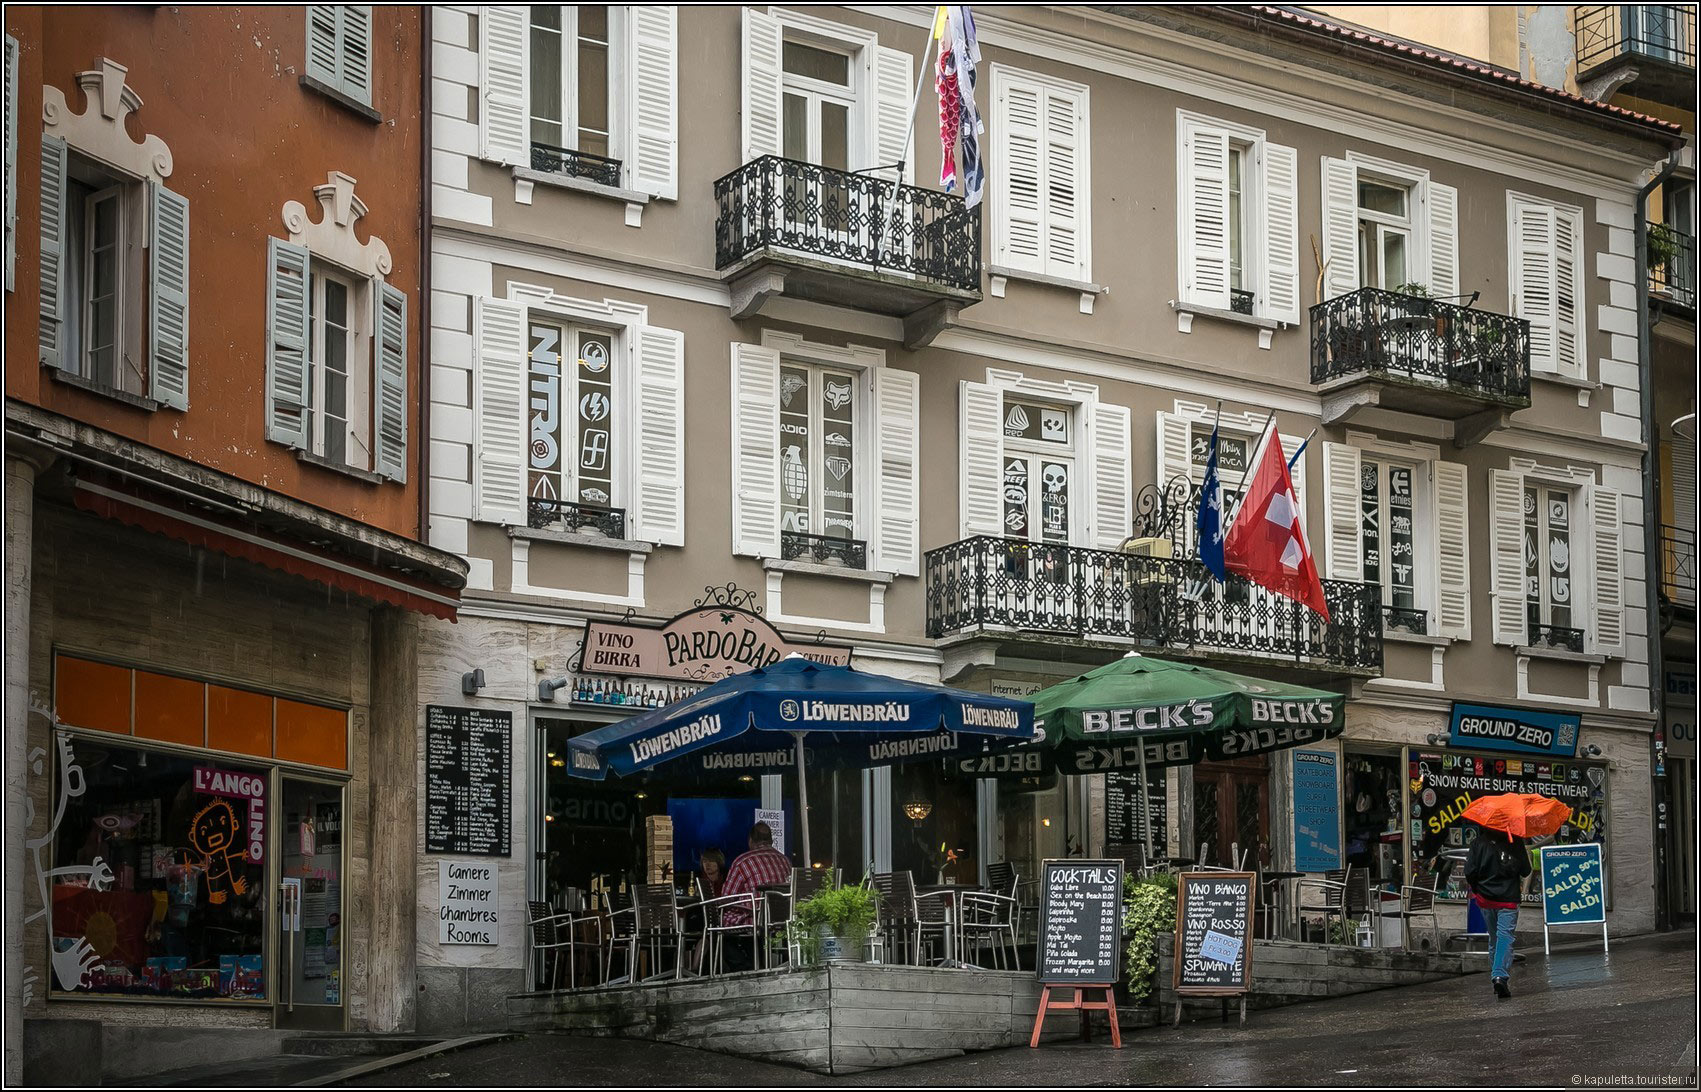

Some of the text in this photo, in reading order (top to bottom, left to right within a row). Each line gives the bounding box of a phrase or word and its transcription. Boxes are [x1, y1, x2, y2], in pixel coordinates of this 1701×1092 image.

[1220, 457, 1242, 467] RVCA
[1004, 475, 1027, 486] REEF
[1042, 492, 1067, 505] ZERO
[1391, 495, 1412, 506] etnies
[599, 632, 634, 649] VINO
[593, 650, 641, 667] BIRRA
[993, 681, 1023, 695] Internet
[803, 700, 910, 722] LÖWENBRÄU
[961, 703, 1019, 729] LÖWENBRÄU
[1082, 698, 1213, 733] BECK'S
[1251, 698, 1334, 724] BECK'S
[1460, 718, 1552, 746] GROUND ZERO
[629, 714, 722, 764] LÖWENBRÄU
[1297, 754, 1334, 765] GROUND ZERO
[1297, 768, 1335, 777] SKATEBOARD
[195, 769, 264, 797] L'ANGO
[1298, 781, 1335, 790] SNOWBOARD
[1429, 774, 1589, 797] SNOW SKATE SURF & STREETWEAR
[1306, 793, 1322, 801] SURF
[759, 811, 780, 820] CAMERE
[1297, 805, 1337, 814] STREETWEAR
[1428, 791, 1472, 834] SALDI
[1309, 818, 1326, 826] SHOP
[1568, 807, 1594, 833] LDI
[250, 798, 264, 860] LINO
[448, 864, 490, 880] Camere
[1550, 862, 1570, 877] 20%
[1579, 859, 1599, 872] 50%
[1050, 868, 1116, 884] COCKTAILS
[1189, 883, 1210, 895] VINO
[1546, 873, 1584, 898] SALDI
[1576, 876, 1600, 897] 30%
[447, 885, 491, 901] Zimmer
[1050, 891, 1062, 899] Sex
[1050, 900, 1068, 909] Bloody
[1070, 900, 1085, 910] Mary
[1560, 894, 1600, 915] SALDI
[440, 905, 497, 922] Chambres
[1187, 912, 1213, 920] Sauvignon
[1048, 925, 1066, 934] Mojito
[1188, 918, 1245, 929] VINO ROSSO
[447, 922, 490, 943] Rooms
[1047, 933, 1061, 942] Apple
[1063, 934, 1082, 943] Mojito
[1208, 935, 1238, 948] HOT DOG
[1060, 949, 1078, 957] Colada
[1045, 957, 1065, 965] Frozen
[1067, 958, 1094, 968] Margarita
[1063, 968, 1079, 976] many
